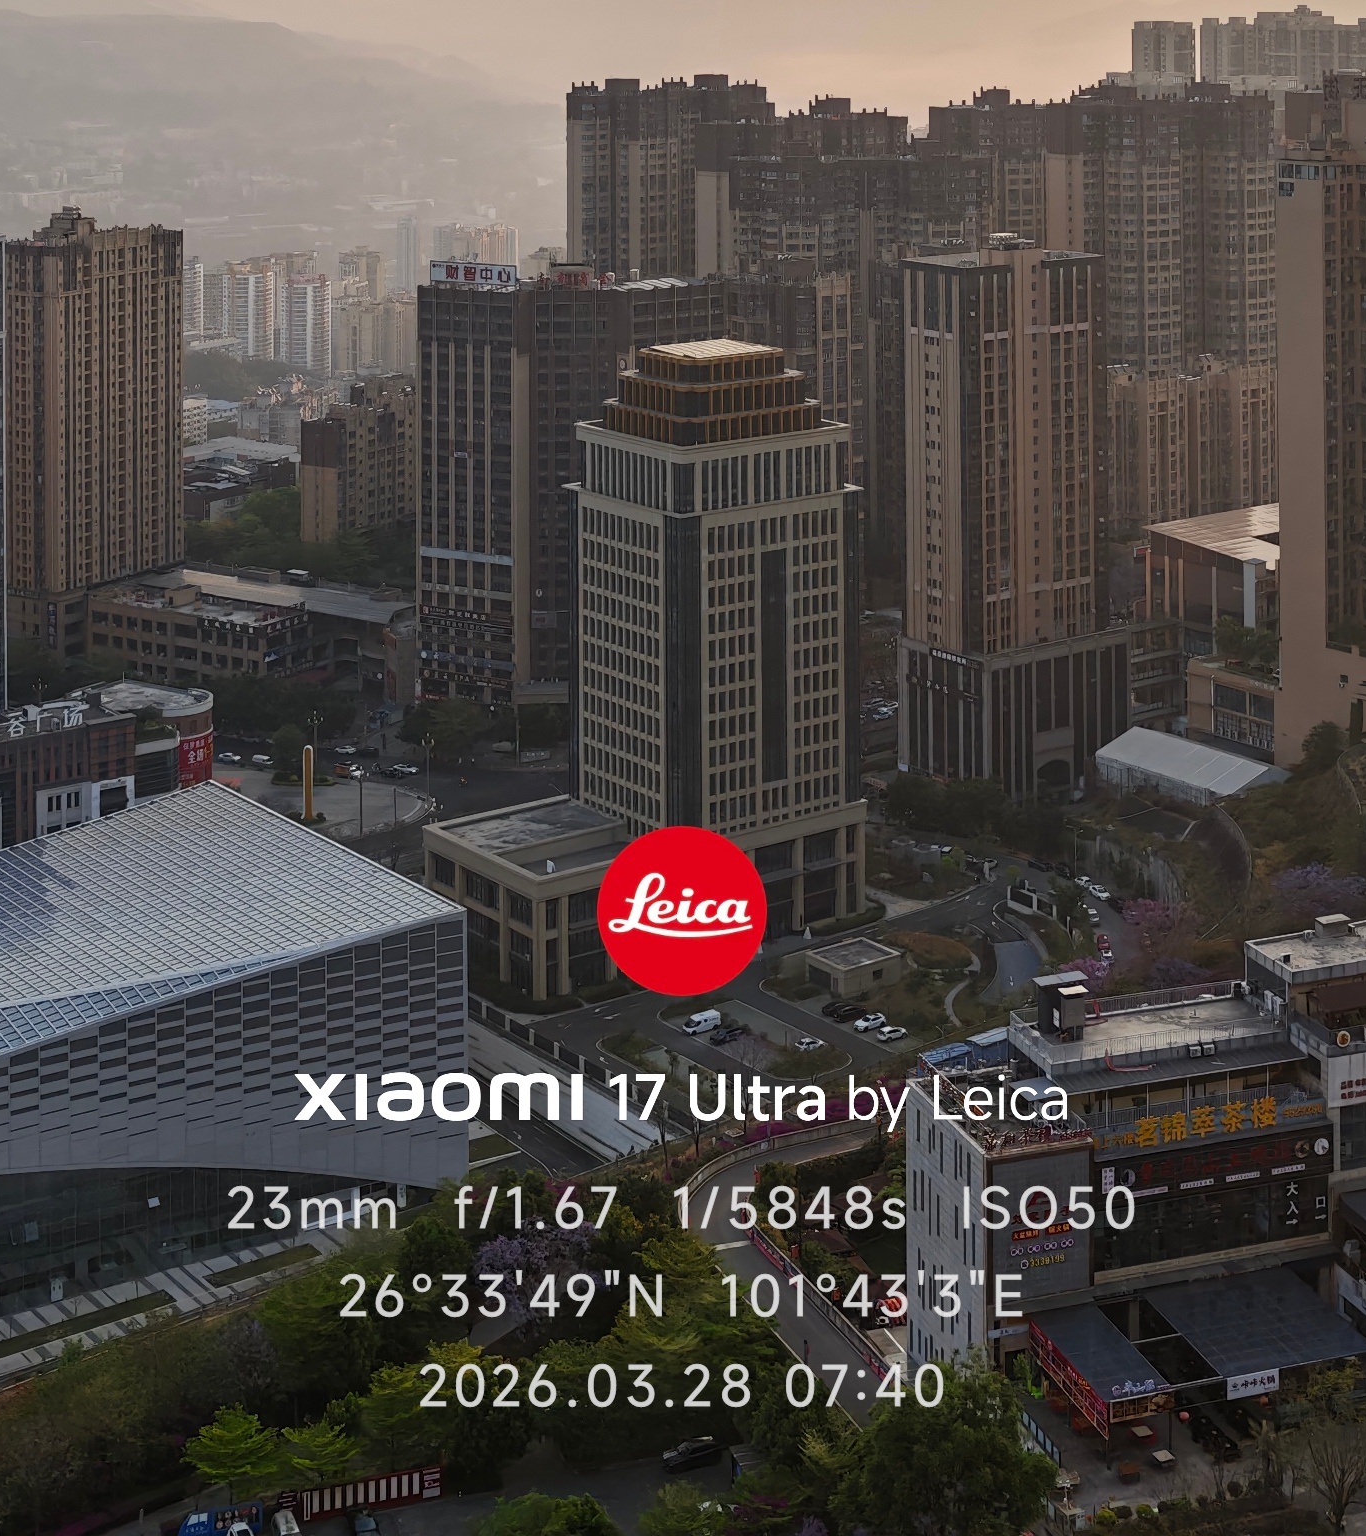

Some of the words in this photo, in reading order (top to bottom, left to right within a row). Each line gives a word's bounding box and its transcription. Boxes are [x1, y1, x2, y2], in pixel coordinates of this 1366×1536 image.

[446, 265, 511, 284] 财智中心
[1135, 1095, 1277, 1148] 茗锦萃茶楼
